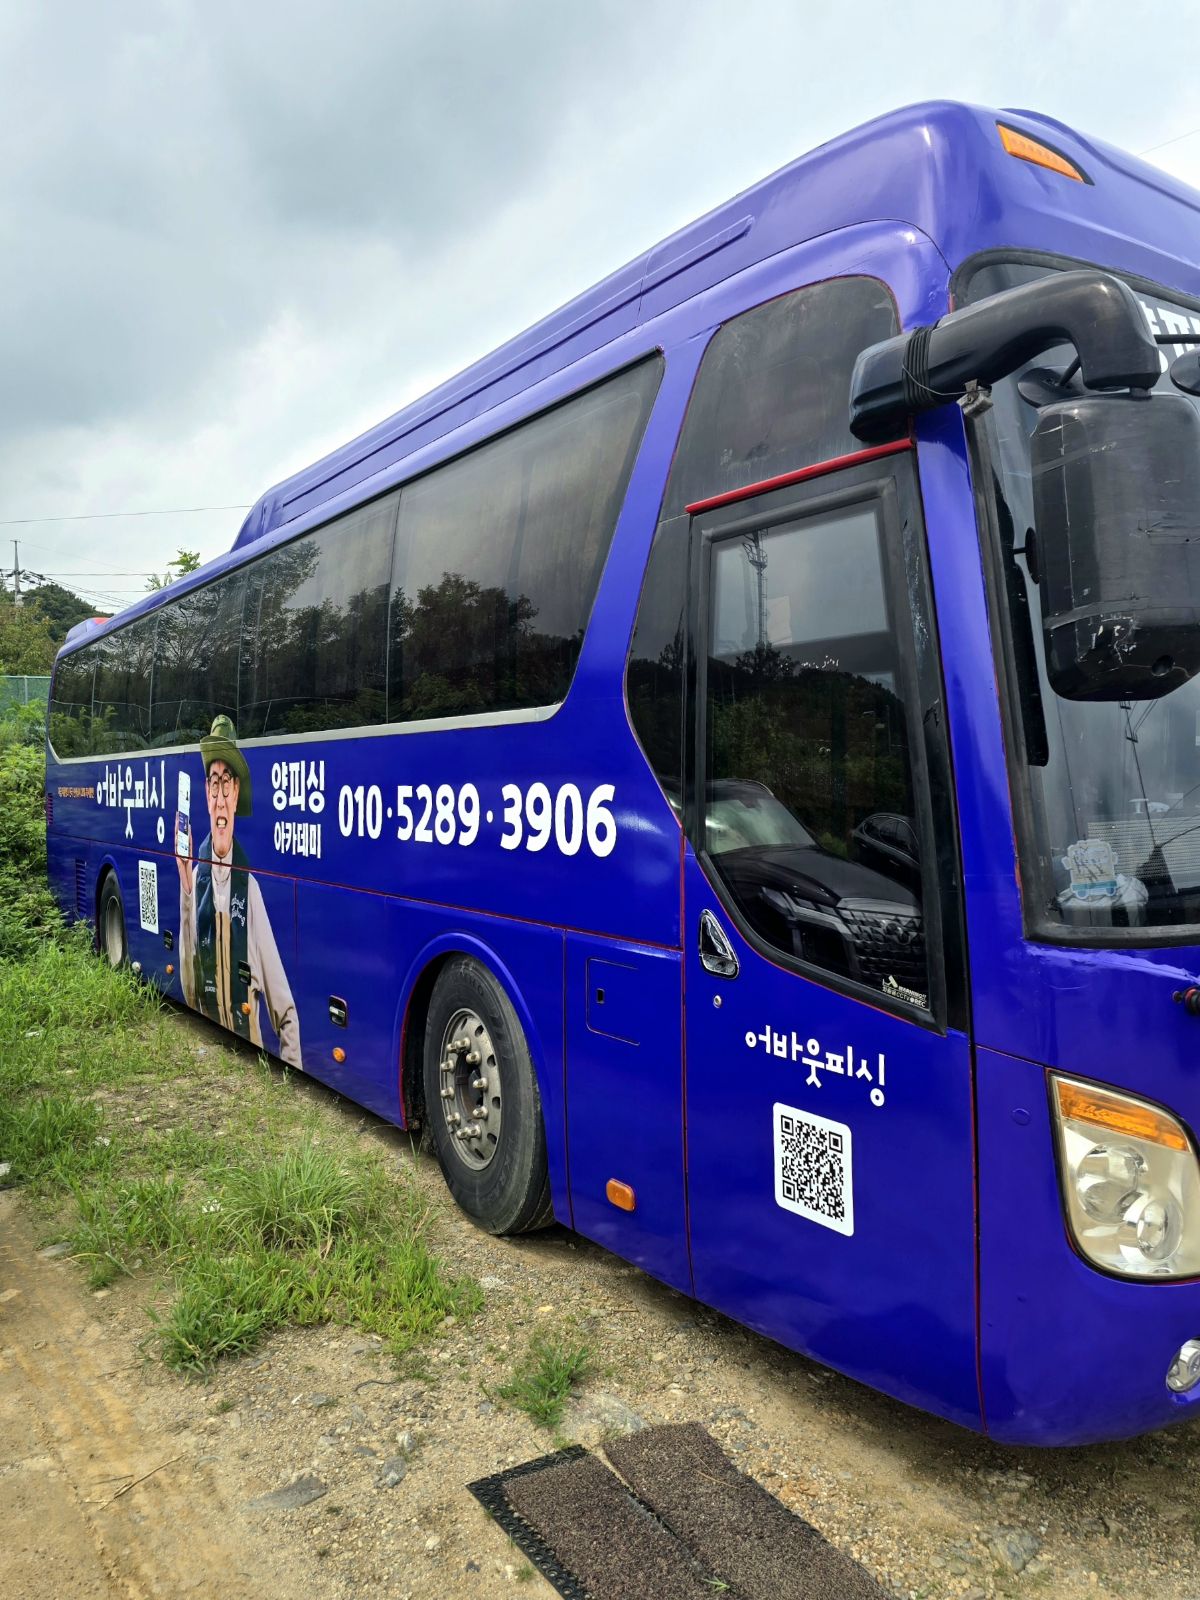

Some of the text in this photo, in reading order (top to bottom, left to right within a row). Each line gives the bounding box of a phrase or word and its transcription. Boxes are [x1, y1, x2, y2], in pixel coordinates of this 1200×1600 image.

[96, 760, 165, 843] 어바웃피싱
[271, 760, 325, 814] 양피싱
[273, 820, 321, 858] 아카데미
[745, 1025, 885, 1107] 어바웃피싱
